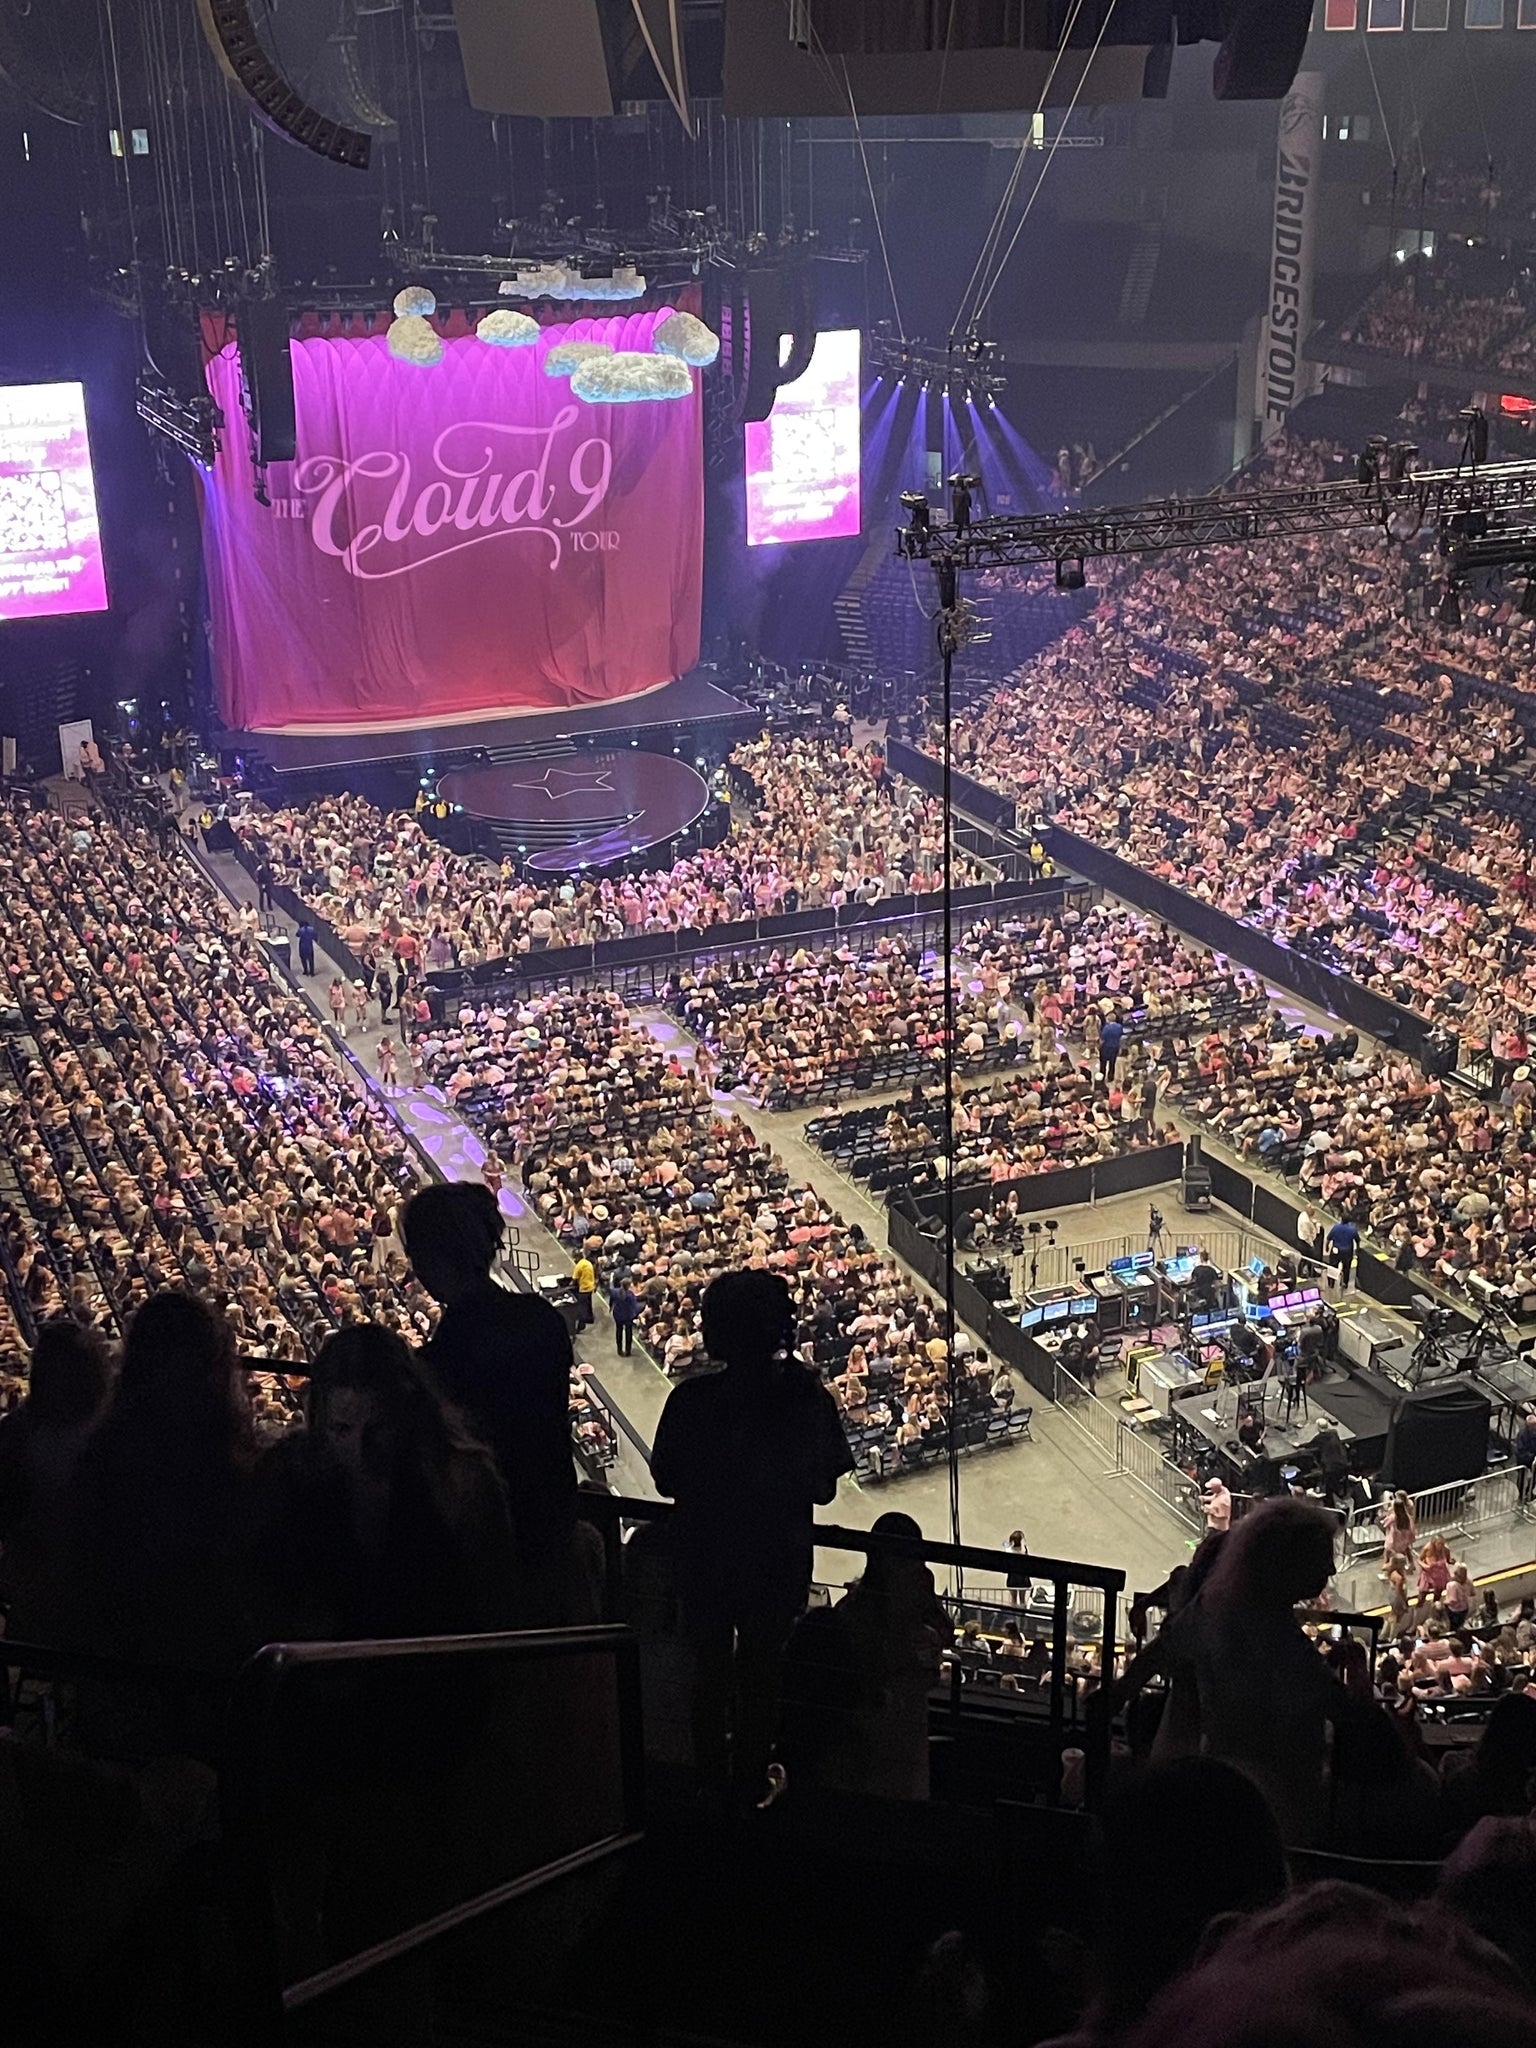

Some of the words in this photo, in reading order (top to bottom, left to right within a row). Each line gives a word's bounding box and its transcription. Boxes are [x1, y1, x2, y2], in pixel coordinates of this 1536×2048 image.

[1266, 149, 1310, 422] BRIDGESTONE
[270, 498, 306, 518] THE
[294, 405, 579, 579] Cloud
[553, 438, 612, 527] 9
[570, 530, 621, 552] TOUR
